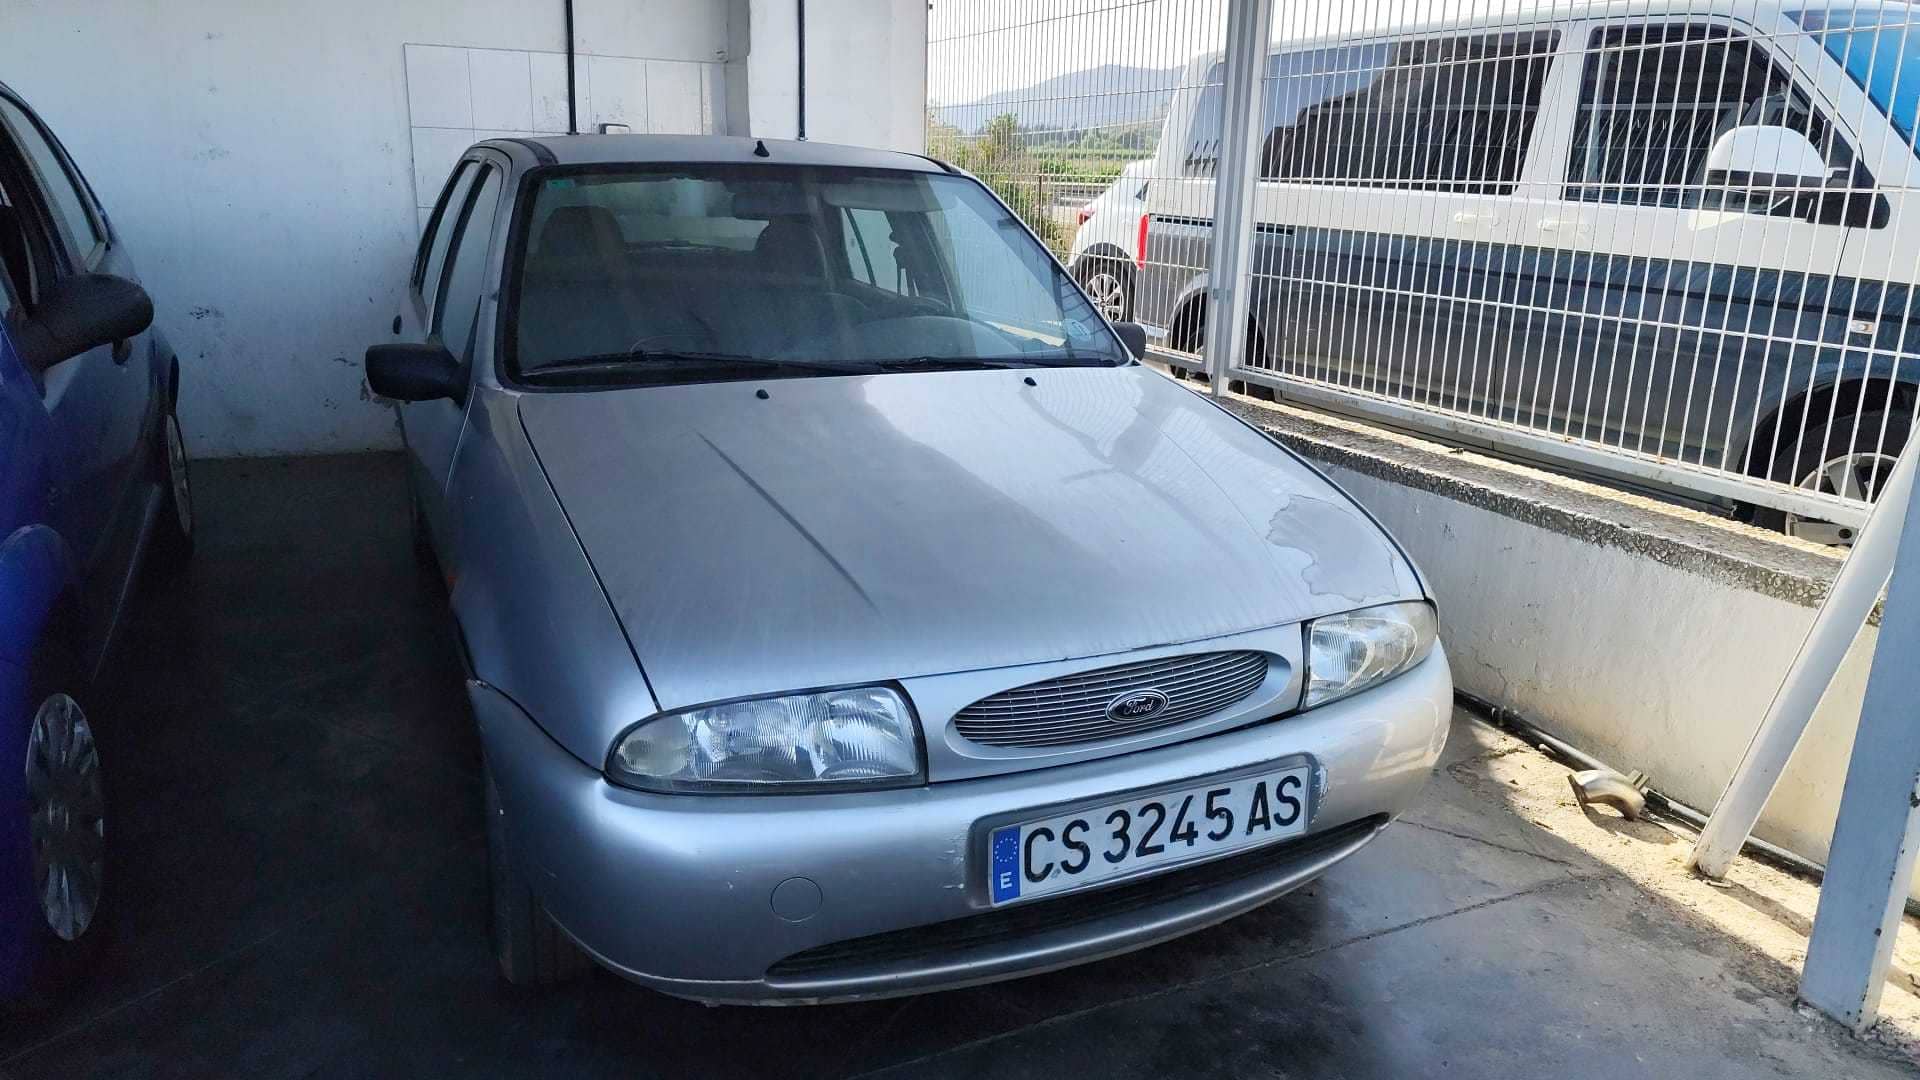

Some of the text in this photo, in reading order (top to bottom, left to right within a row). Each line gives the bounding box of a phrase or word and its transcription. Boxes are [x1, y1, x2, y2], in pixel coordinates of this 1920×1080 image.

[1123, 697, 1154, 715] Ford
[1024, 775, 1301, 883] CS 3245 AS
[1000, 871, 1012, 889] E
